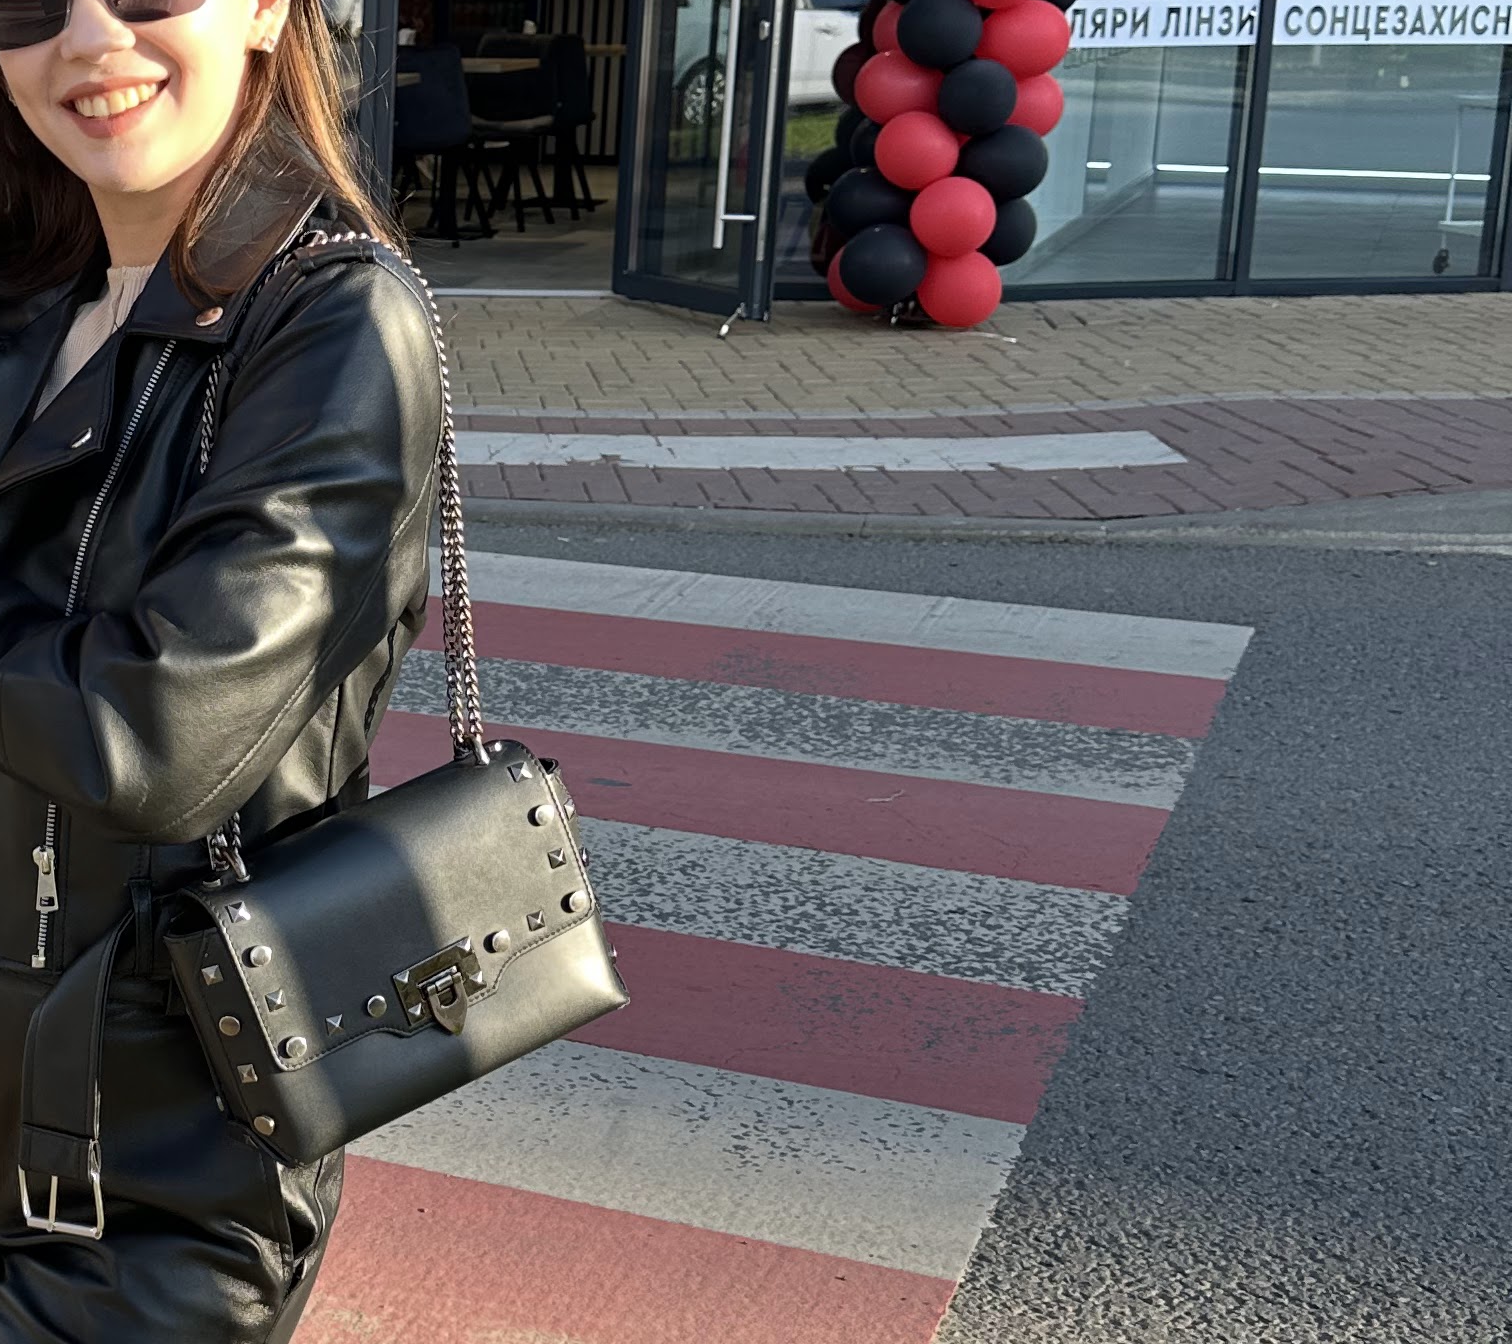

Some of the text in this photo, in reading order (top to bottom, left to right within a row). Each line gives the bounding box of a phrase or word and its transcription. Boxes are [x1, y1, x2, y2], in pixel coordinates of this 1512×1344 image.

[1070, 4, 1512, 41] ЛЯРИ ЛІНЗИ СОНЦЕЗАХИСН
